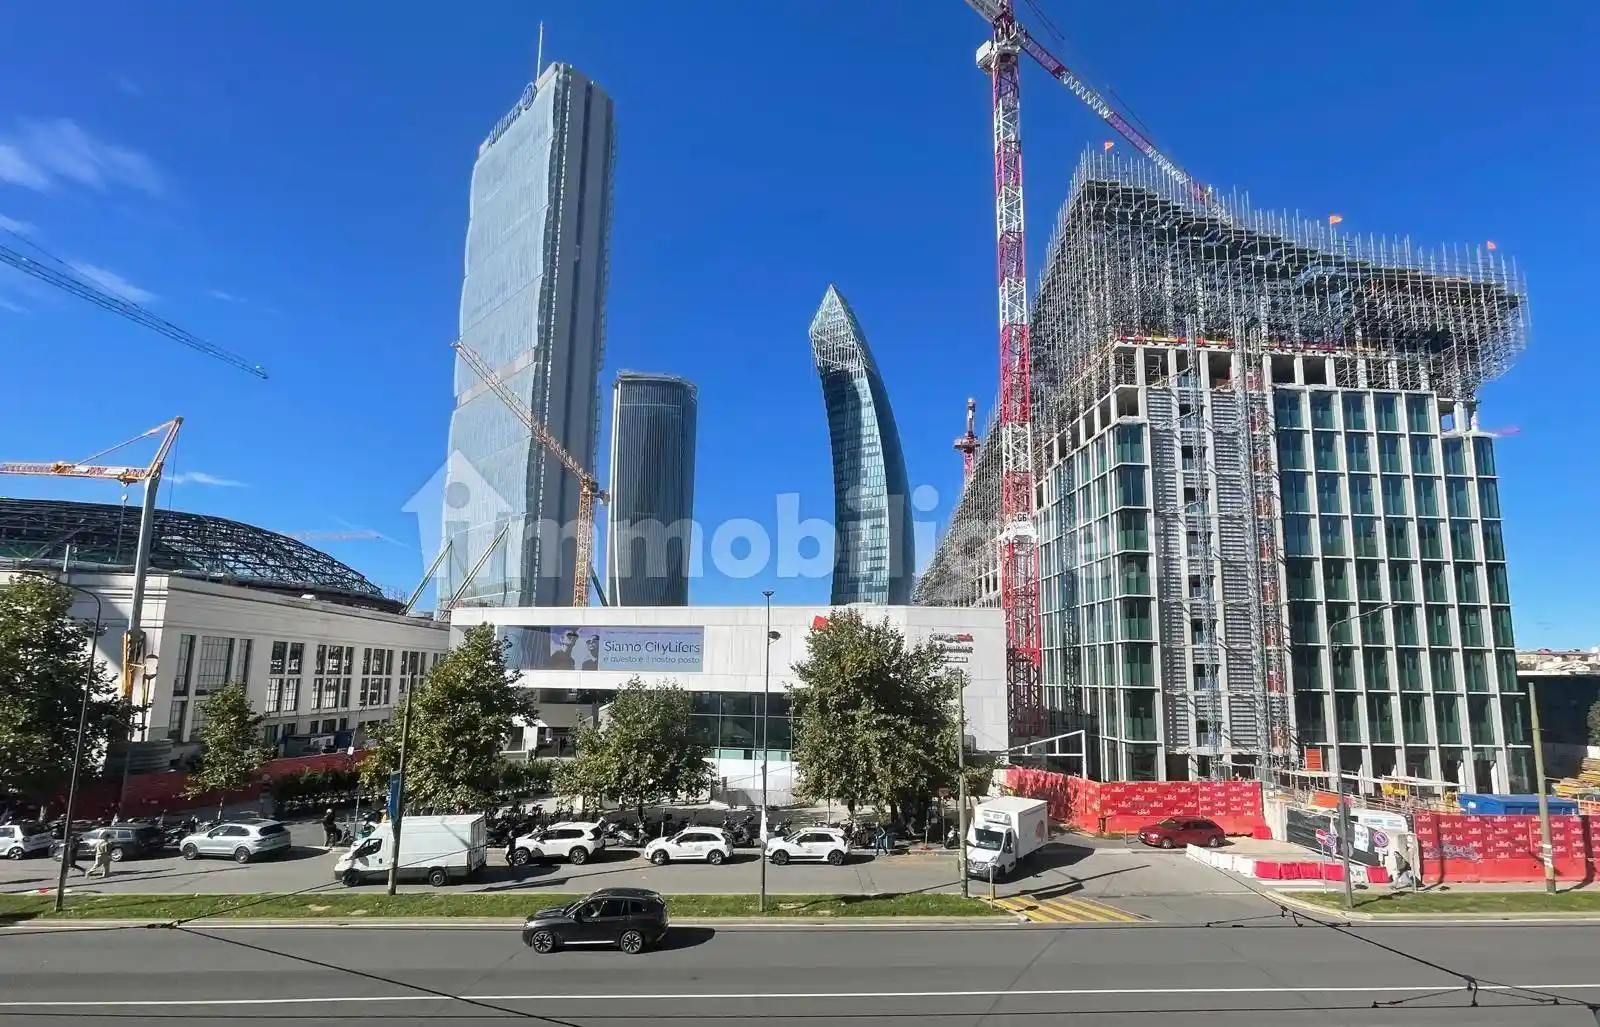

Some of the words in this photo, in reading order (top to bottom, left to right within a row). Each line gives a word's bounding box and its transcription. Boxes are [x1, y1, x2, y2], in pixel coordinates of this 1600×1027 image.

[604, 641, 641, 652] Siamo
[610, 655, 637, 664] questo
[678, 656, 700, 665] posto
